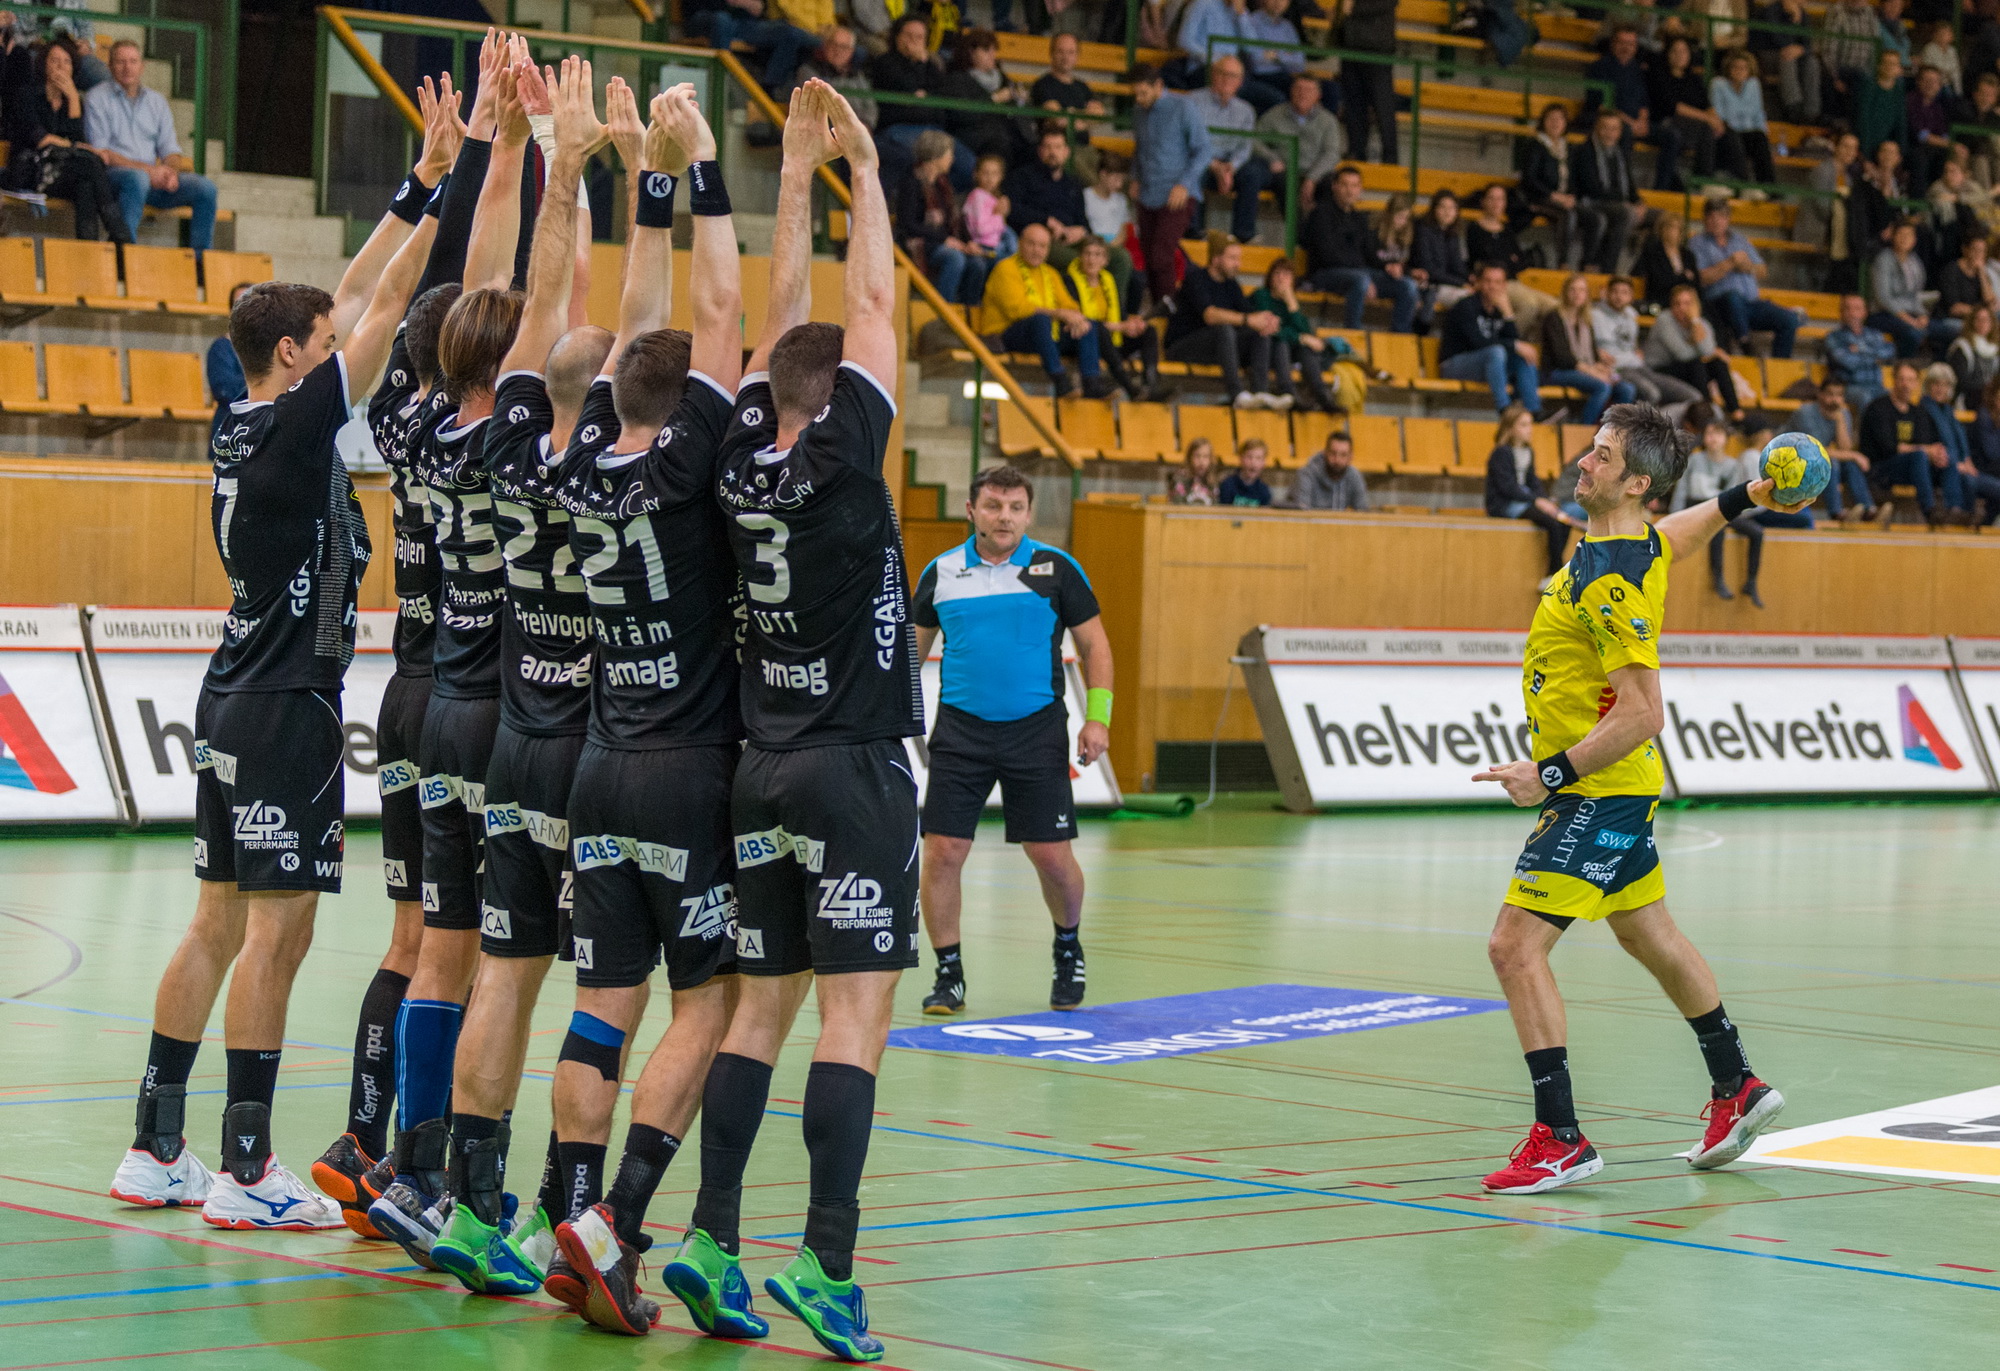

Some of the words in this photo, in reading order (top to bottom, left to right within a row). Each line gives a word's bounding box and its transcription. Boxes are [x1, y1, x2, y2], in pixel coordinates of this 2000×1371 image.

[573, 513, 670, 605] 21
[736, 513, 790, 604] 3
[103, 621, 192, 639] UMBAUTEN
[520, 653, 592, 687] amag
[605, 651, 680, 689] amag
[1667, 701, 1894, 761] helvetia
[487, 808, 523, 830] ABS
[244, 840, 299, 850] PERFORMANCE
[273, 831, 299, 840] ZONE4
[738, 836, 777, 863] ABS
[1518, 884, 1549, 899] Kempa
[832, 917, 893, 929] PERFORMANCE
[354, 1073, 383, 1124] Kempa
